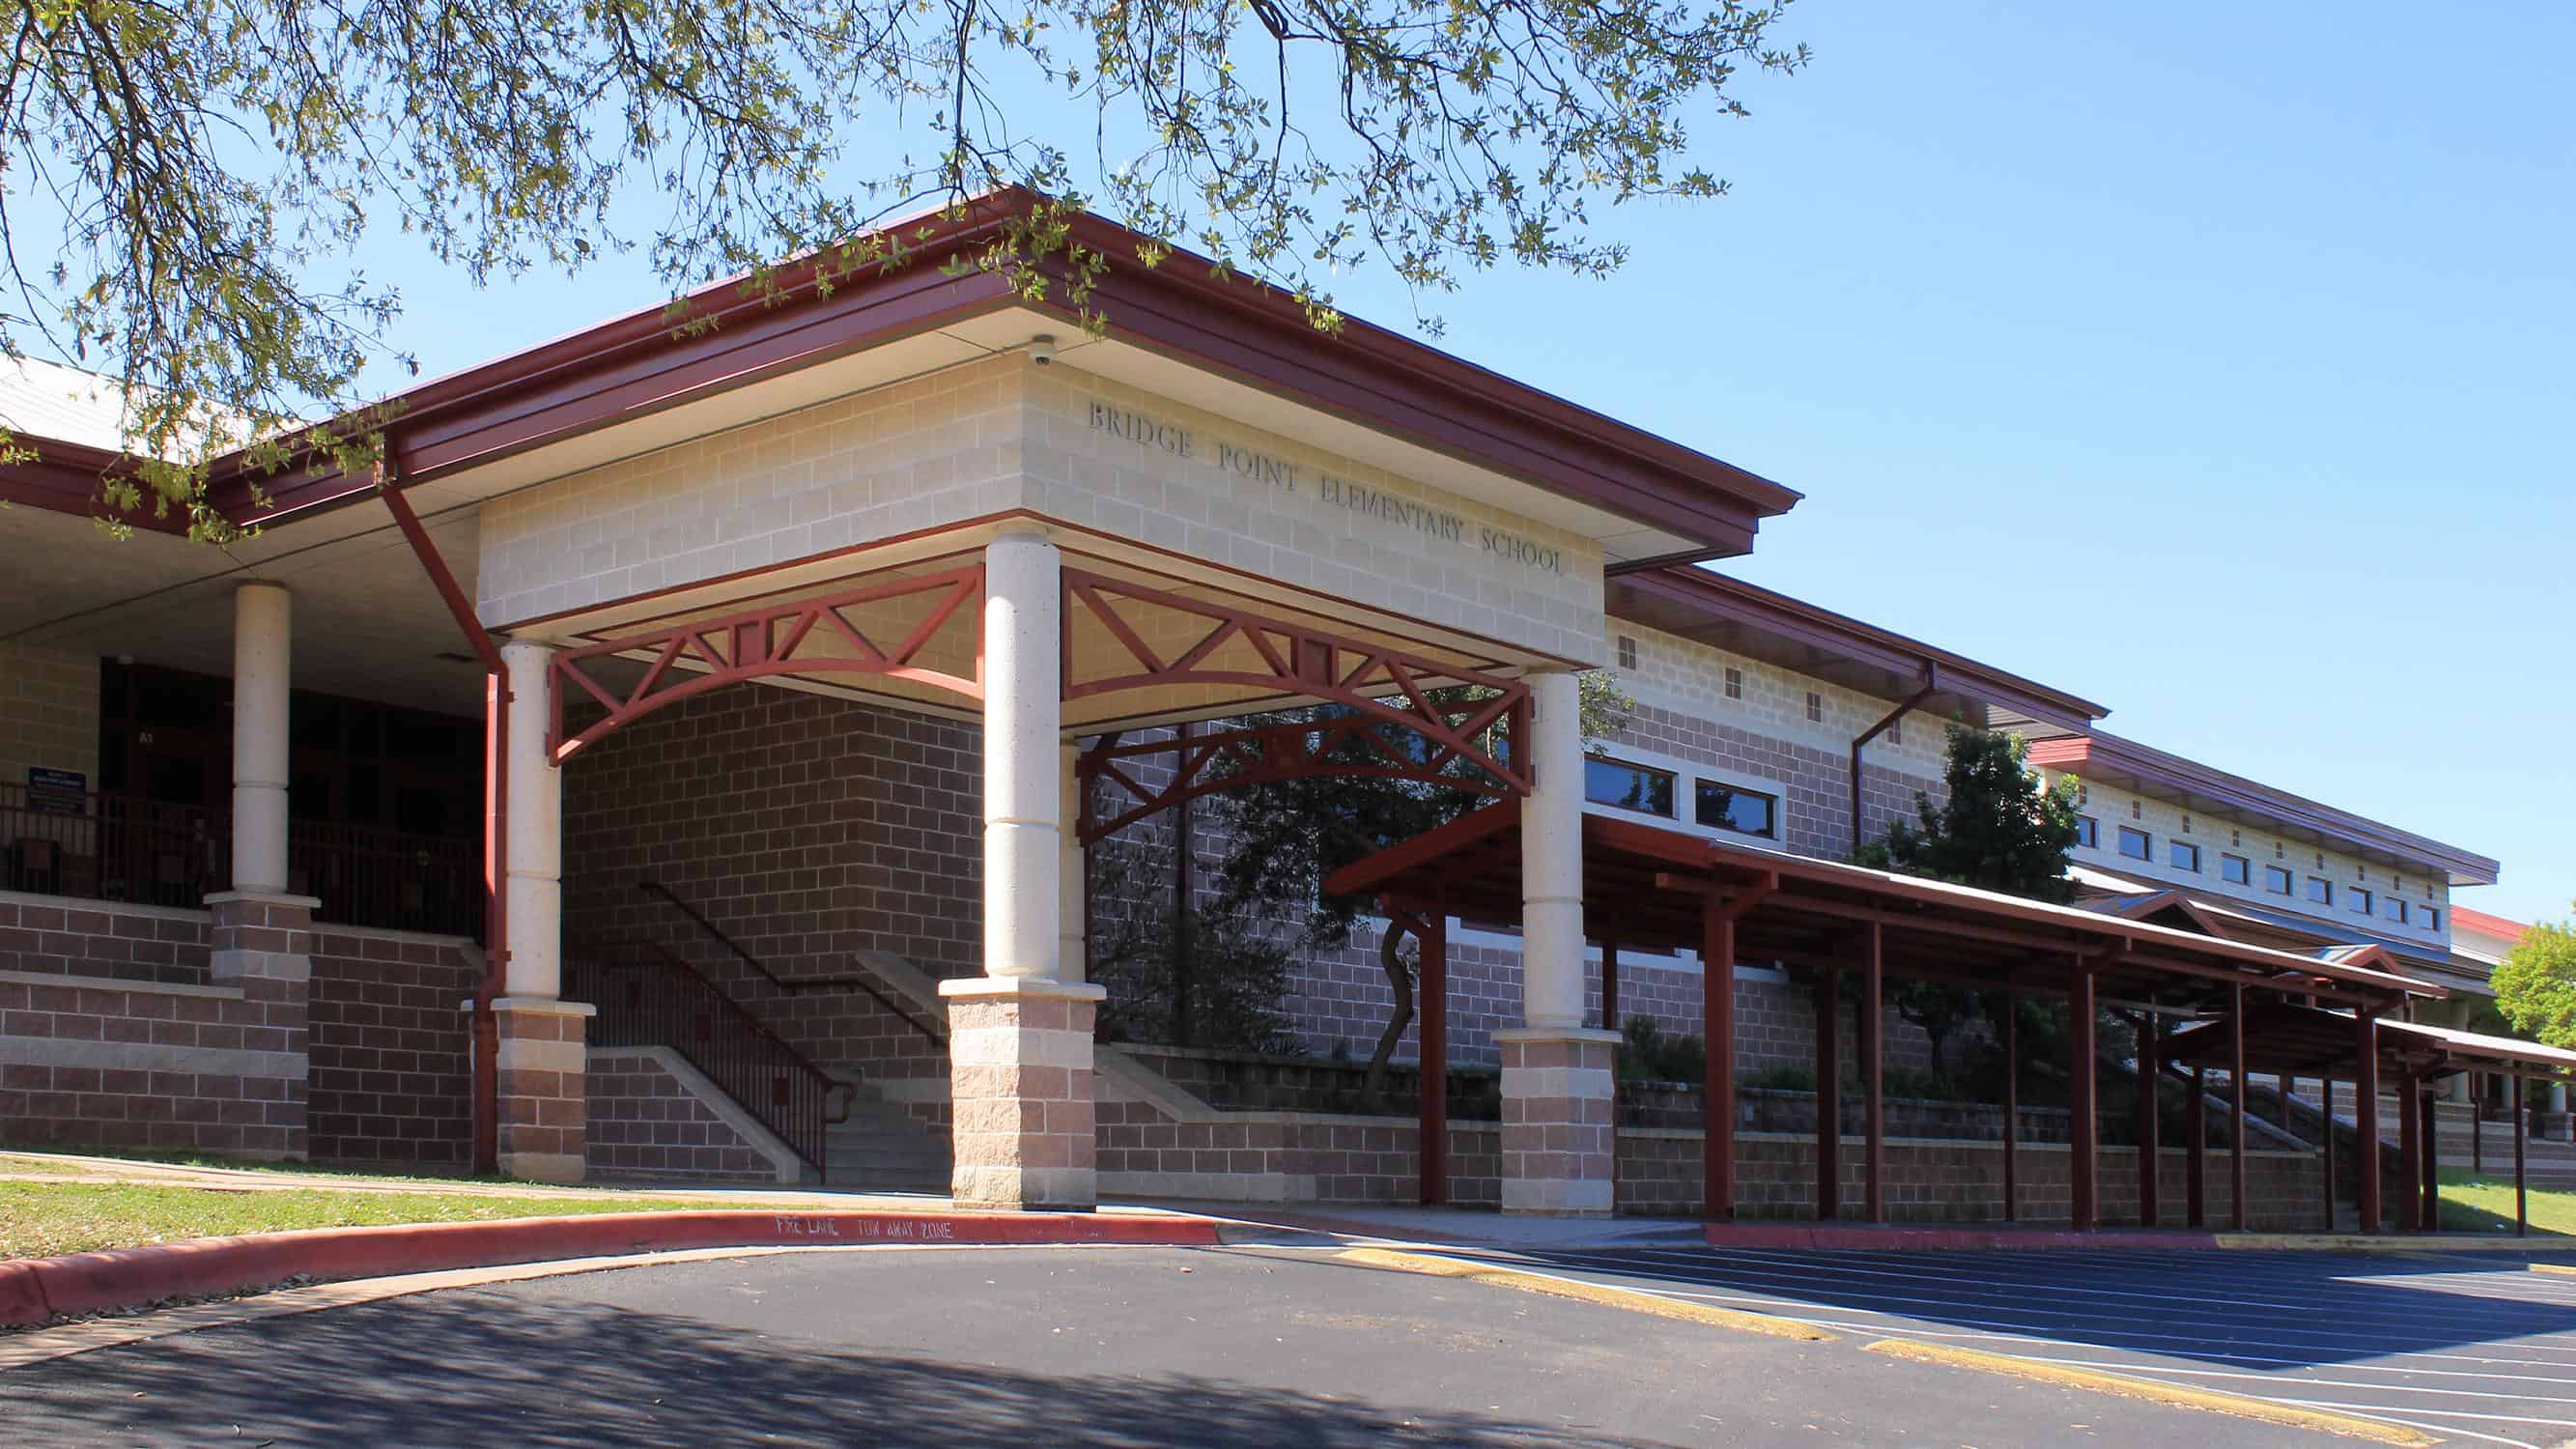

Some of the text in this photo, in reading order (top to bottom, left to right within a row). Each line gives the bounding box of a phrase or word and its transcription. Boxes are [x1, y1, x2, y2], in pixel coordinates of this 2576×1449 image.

[1088, 401, 1565, 577] BRIDGE POINT ELEMENTARY SCHOOL
[807, 1218, 838, 1236] LANE
[920, 1221, 953, 1238] ZONE
